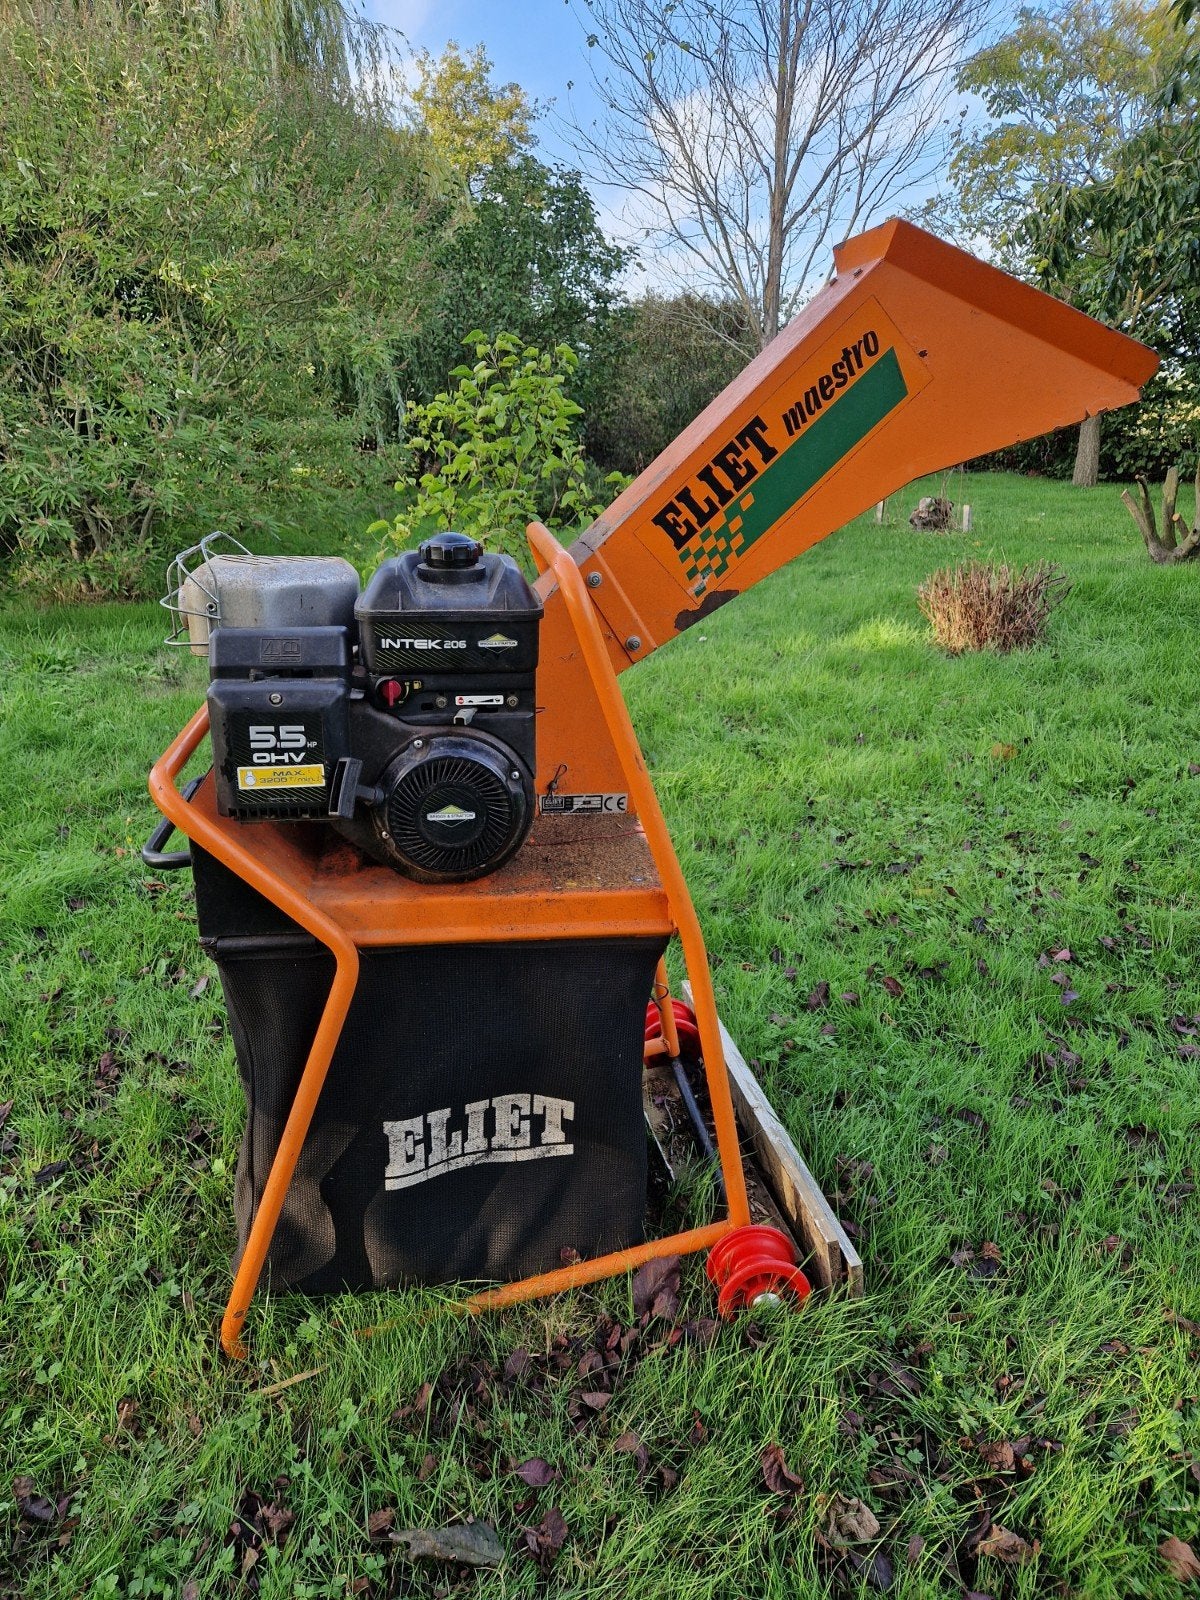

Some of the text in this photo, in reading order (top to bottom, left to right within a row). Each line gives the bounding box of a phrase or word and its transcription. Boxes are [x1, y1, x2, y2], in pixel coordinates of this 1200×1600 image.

[651, 330, 880, 550] ELIET maestro
[381, 638, 467, 649] INTEK 206
[249, 726, 307, 749] 5.5
[252, 752, 305, 763] OHV
[383, 1093, 574, 1178] ELIET
